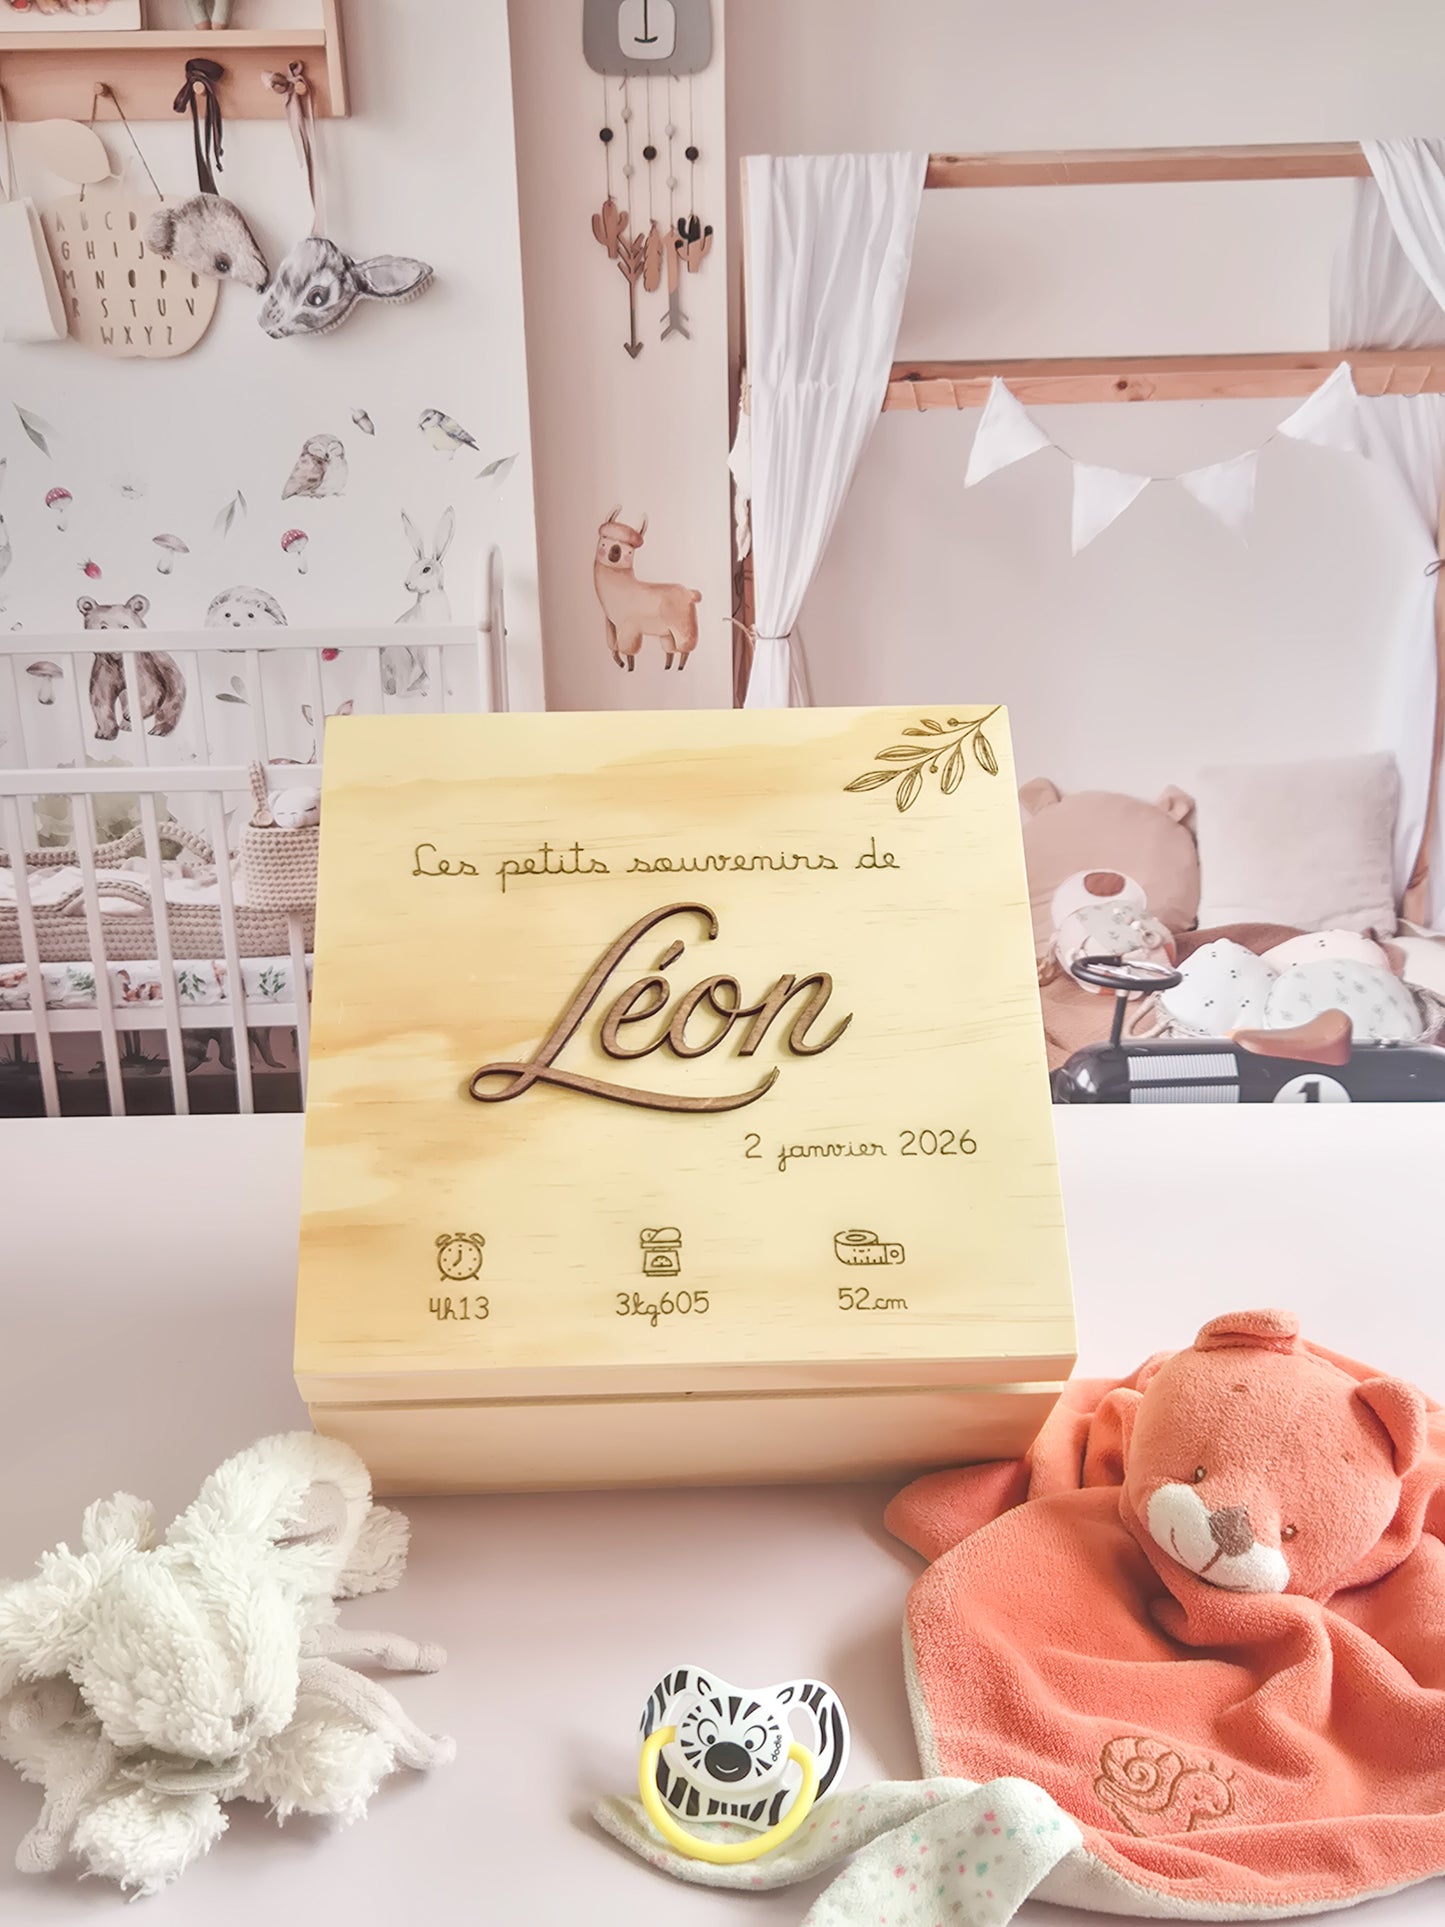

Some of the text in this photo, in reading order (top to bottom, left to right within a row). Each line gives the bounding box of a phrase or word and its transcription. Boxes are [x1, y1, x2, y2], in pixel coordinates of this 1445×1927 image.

[55, 211, 137, 232] A B C D
[61, 240, 144, 260] G H I J
[62, 269, 76, 289] M
[95, 270, 105, 289] N
[128, 269, 136, 288] O
[160, 269, 167, 289] P
[72, 297, 195, 318] R S T U V
[100, 326, 173, 345] W X Y Z
[411, 836, 901, 894] Les petits souvenirs de
[468, 901, 853, 1113] Léon
[1297, 1081, 1320, 1103] 1
[743, 1128, 978, 1173] 2 janvier 2026
[428, 1295, 490, 1321] 4h13
[615, 1290, 710, 1328] 3kg605
[771, 1733, 783, 1762] dodie
